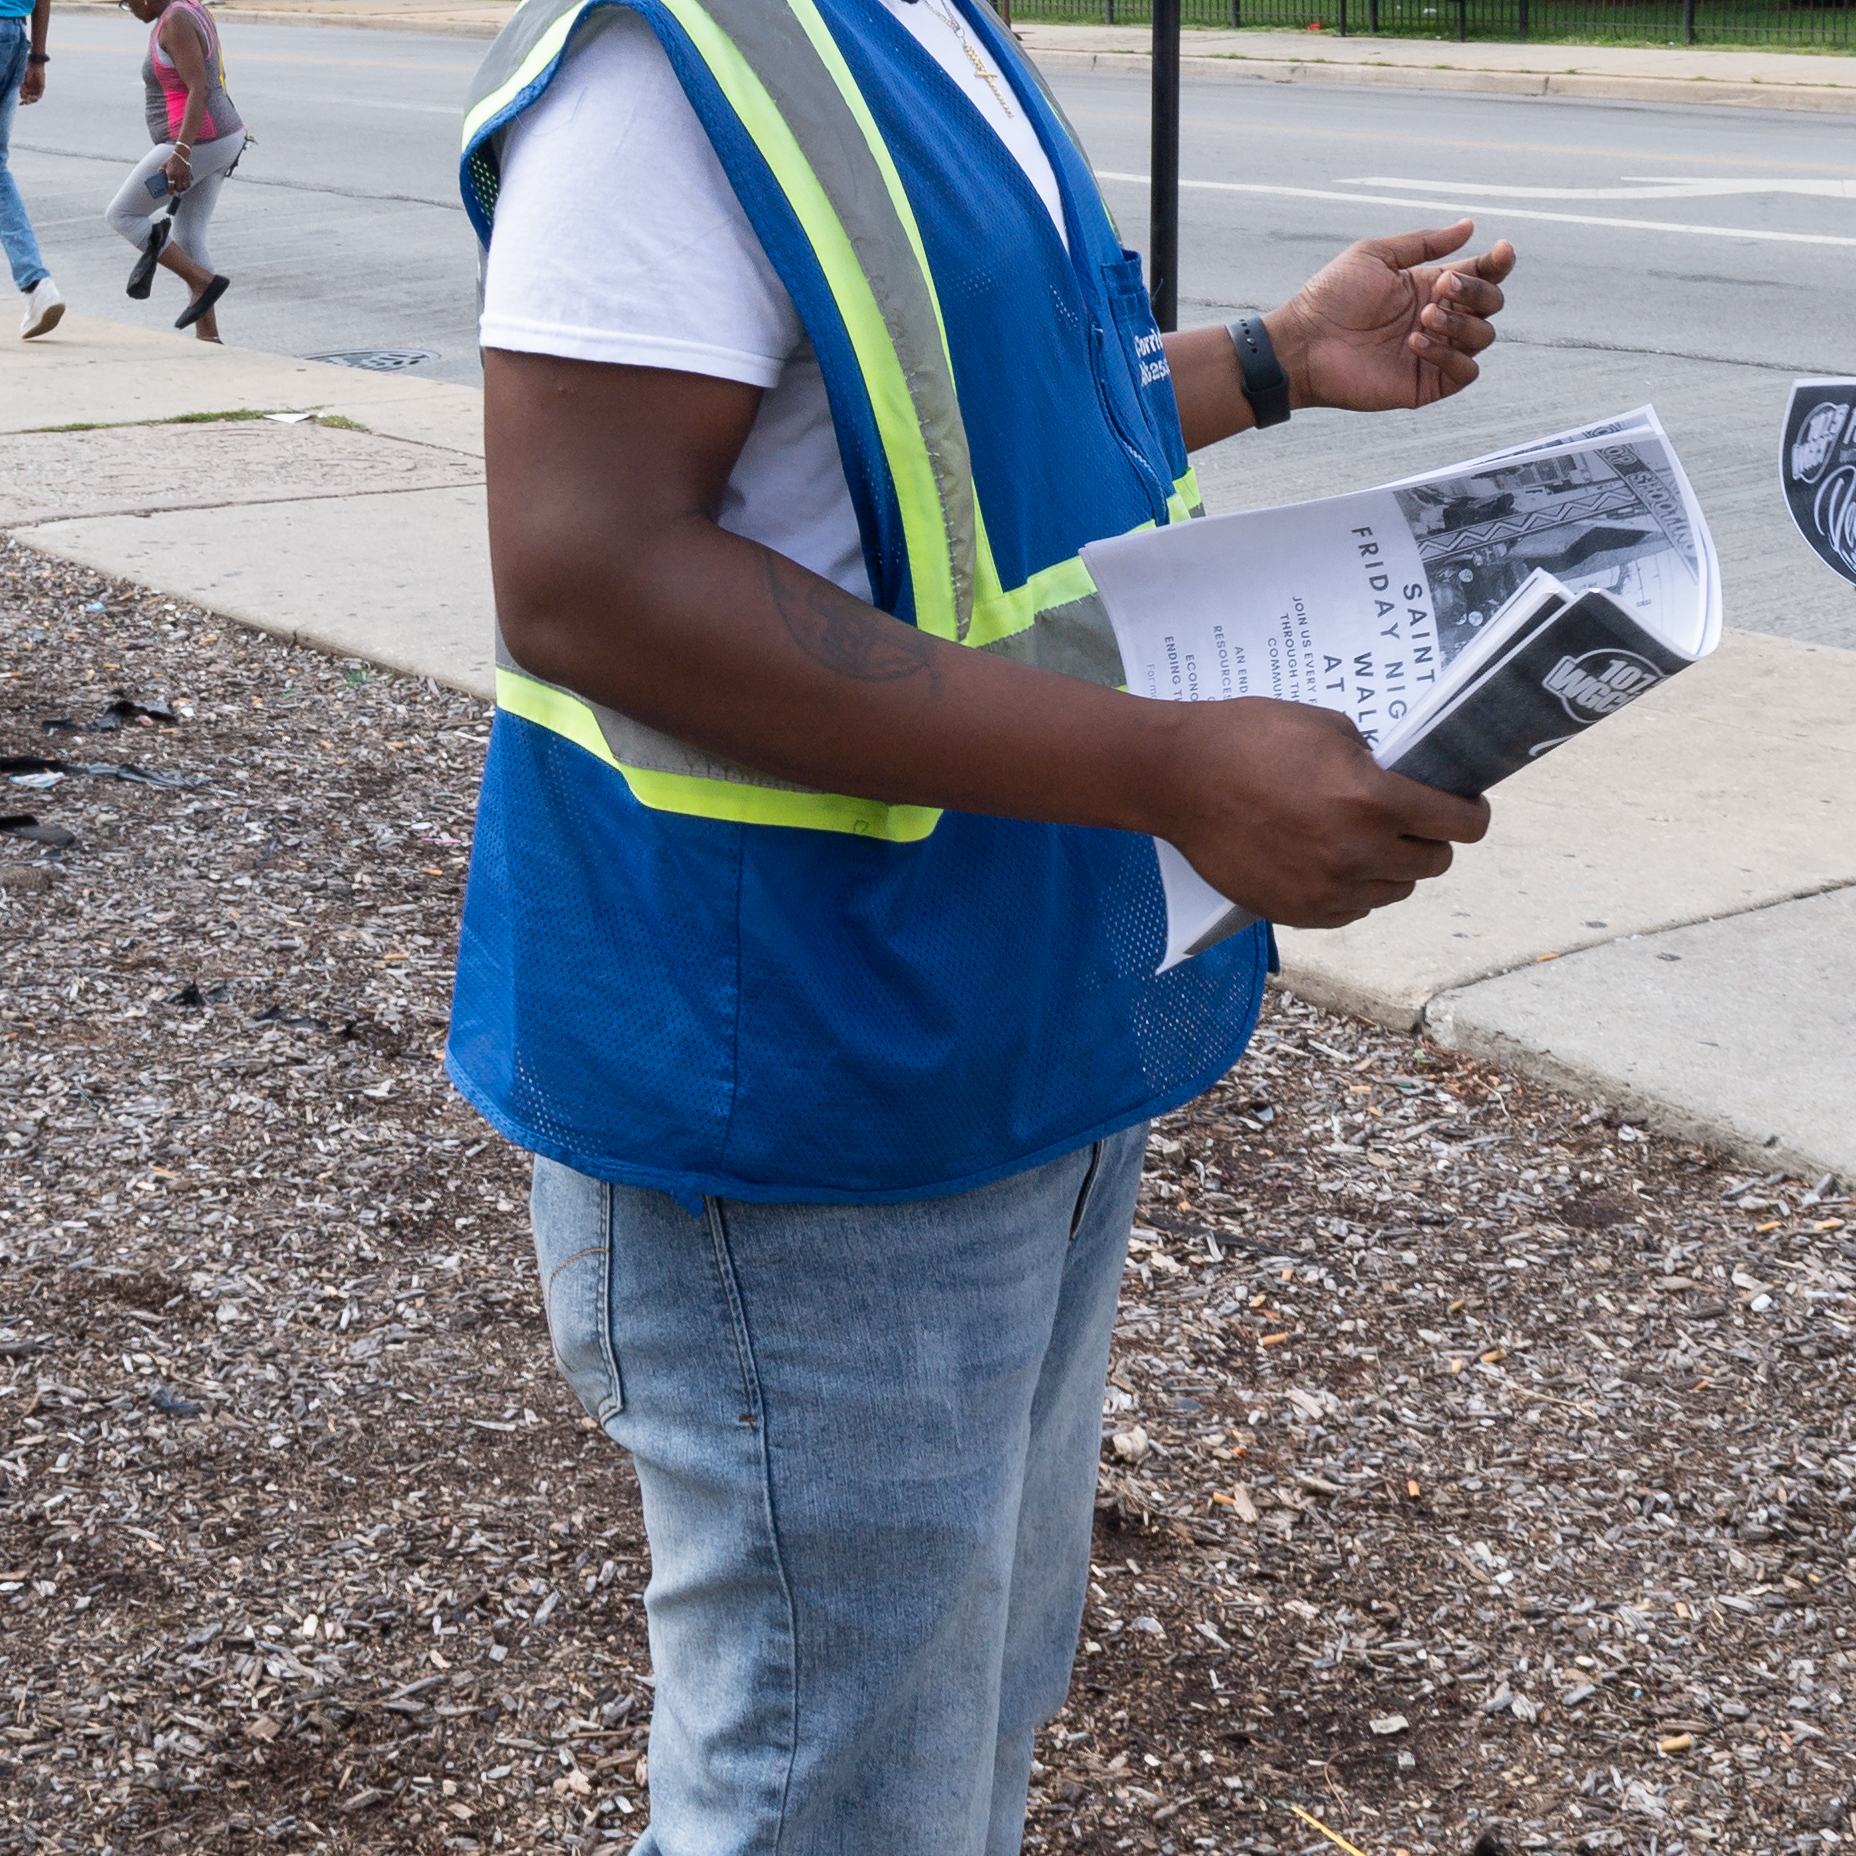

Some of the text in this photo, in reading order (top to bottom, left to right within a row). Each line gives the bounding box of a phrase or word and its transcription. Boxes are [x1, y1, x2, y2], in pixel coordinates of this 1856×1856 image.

[1351, 526, 1400, 640] FRIDAY
[1292, 596, 1307, 626] JOIN
[1402, 583, 1436, 684] SAINT
[1164, 635, 1182, 686] ENDING
[1280, 613, 1299, 677] THROUGH
[1300, 631, 1312, 647] US
[1147, 663, 1156, 678] For
[1234, 646, 1248, 693] AN END
[1303, 650, 1317, 693] EVERY
[1323, 655, 1345, 692] AT
[1353, 651, 1379, 744] WALK
